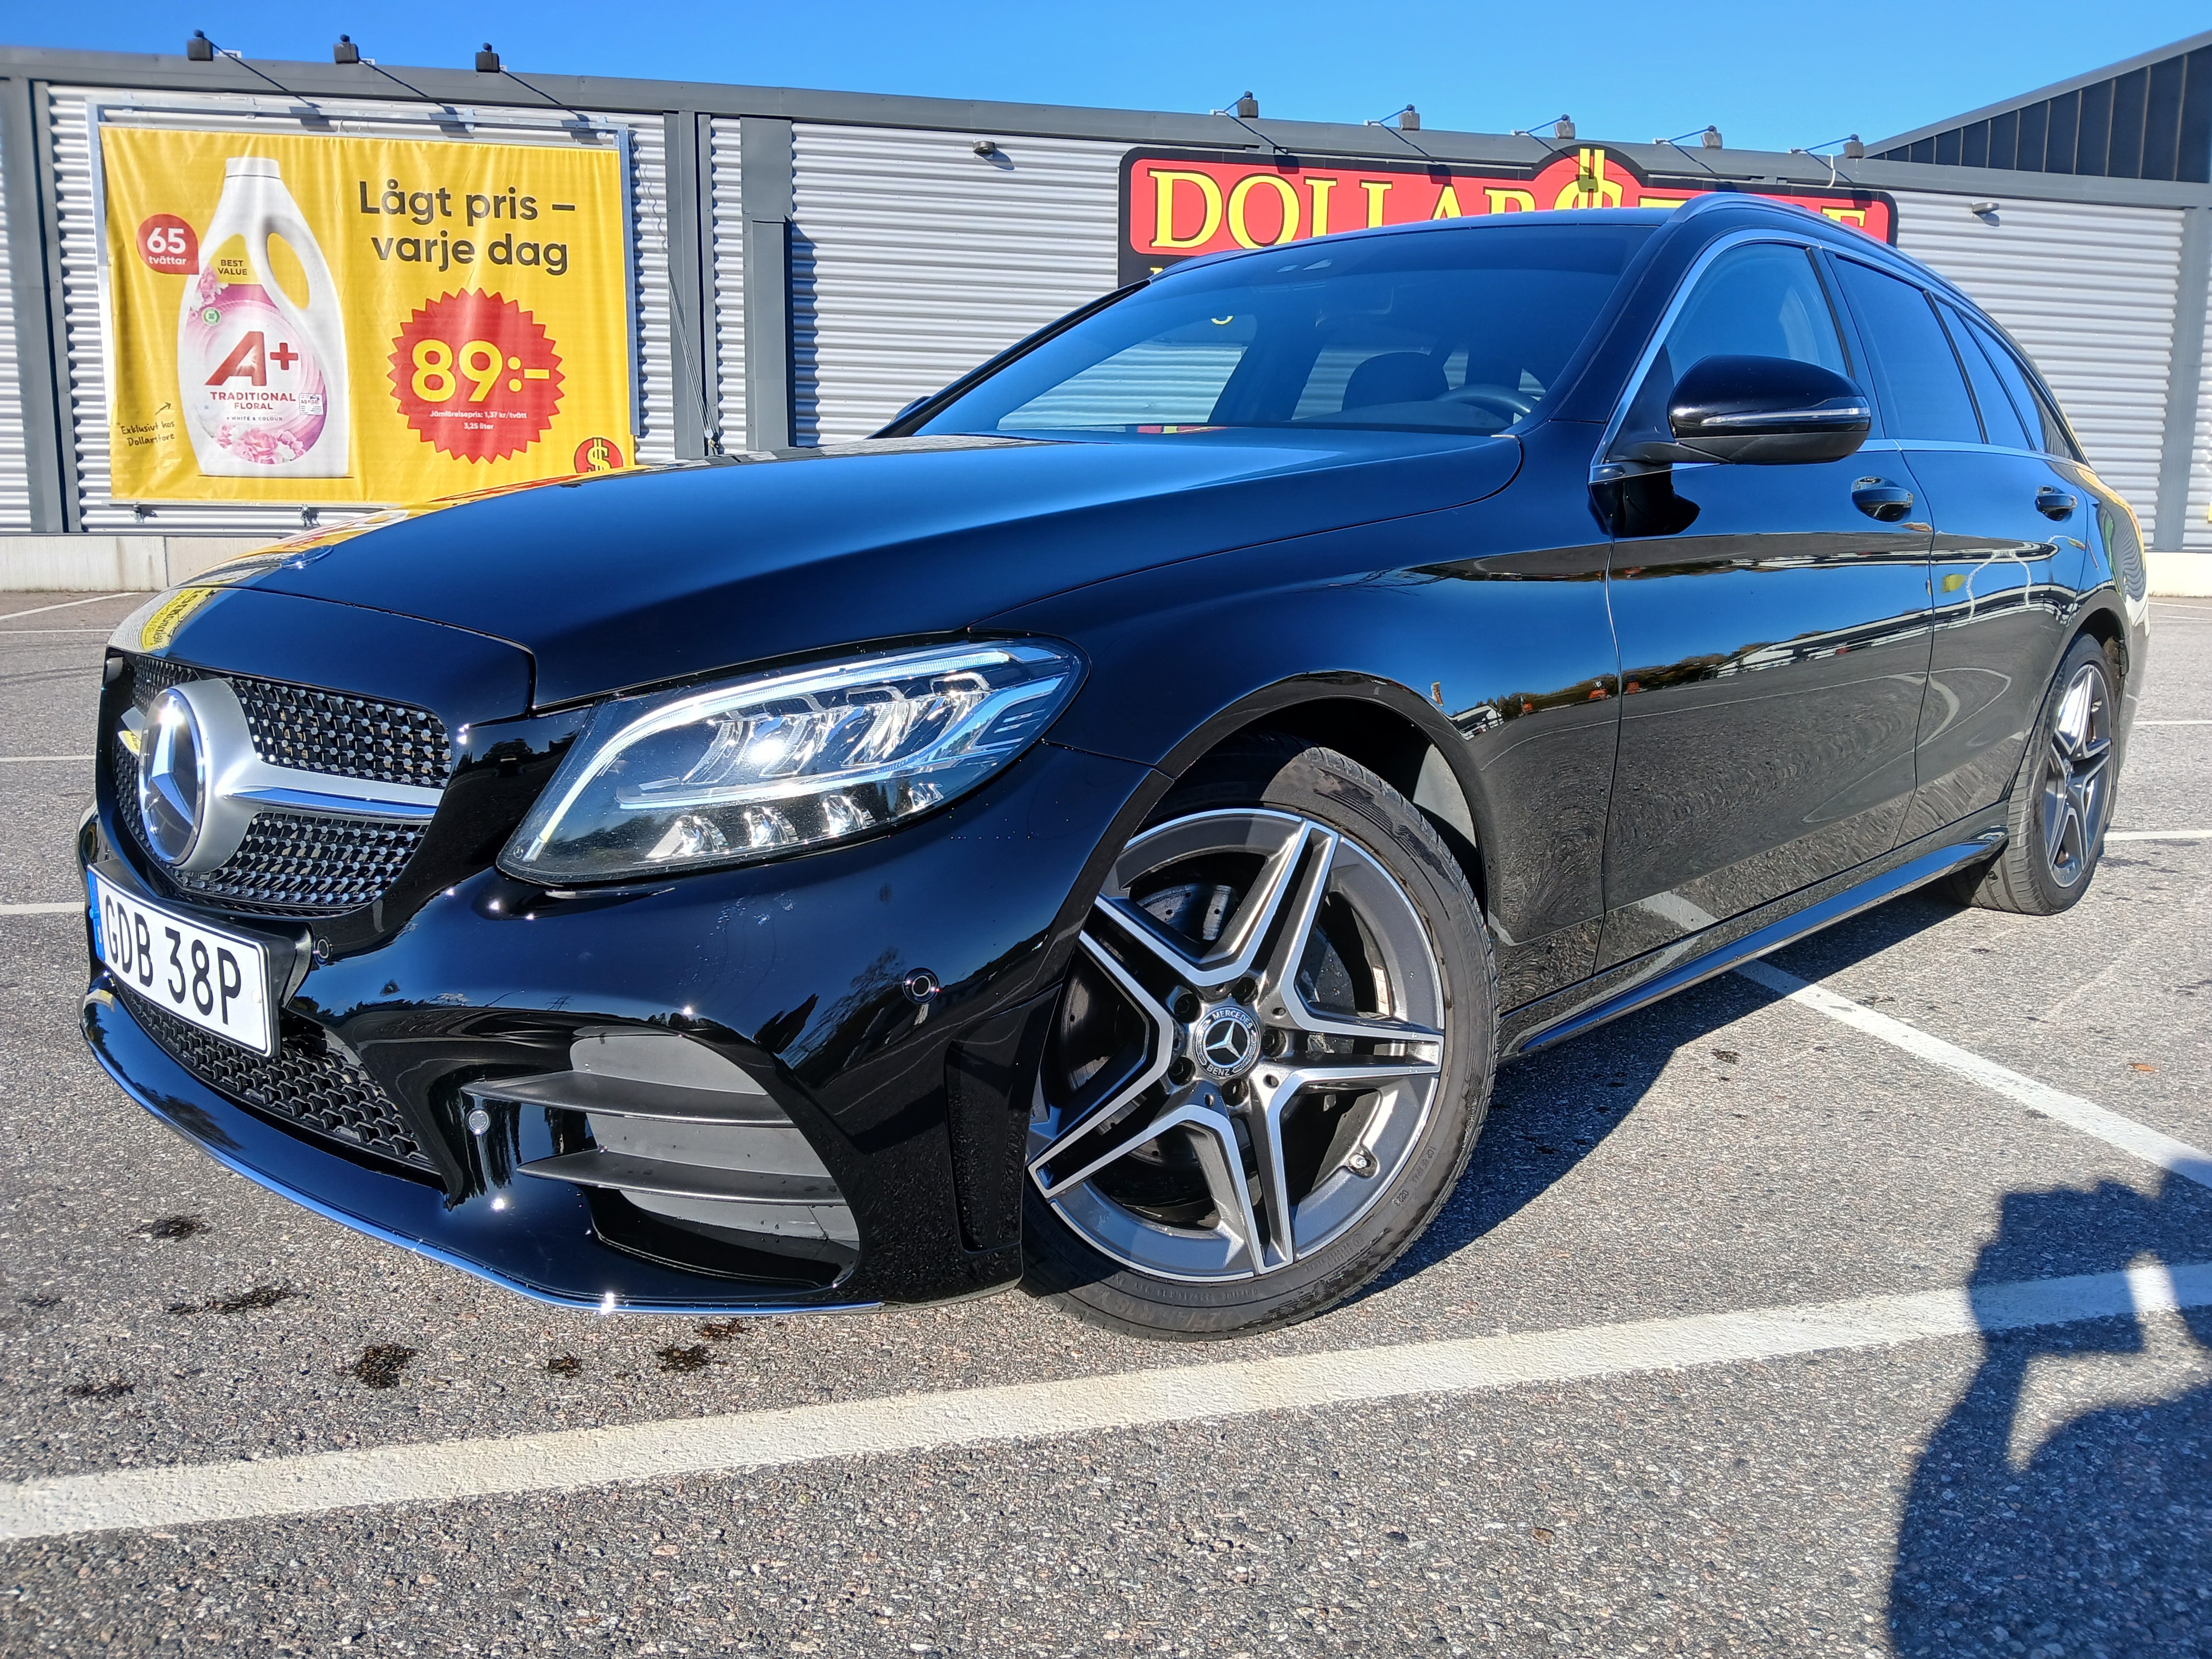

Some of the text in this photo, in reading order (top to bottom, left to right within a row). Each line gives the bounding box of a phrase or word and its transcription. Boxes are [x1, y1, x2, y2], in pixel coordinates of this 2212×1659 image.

[359, 178, 452, 225] Lågt
[465, 186, 538, 227] pris
[147, 227, 186, 254] 65
[370, 229, 568, 275] varje dag
[148, 255, 187, 265] tvättar
[220, 259, 243, 267] BEST
[218, 267, 248, 275] VALUE
[204, 330, 299, 387] A+
[210, 391, 297, 402] TRADITIONAL
[429, 410, 484, 419] Jämförelsepris:
[120, 422, 159, 435] Exklusivt
[464, 422, 479, 430] 3,25
[126, 434, 175, 447] Dollarstore
[105, 893, 242, 1026] GDB 38P
[1212, 1009, 1253, 1030] MERCEDES
[1206, 1064, 1231, 1076] BENZ
